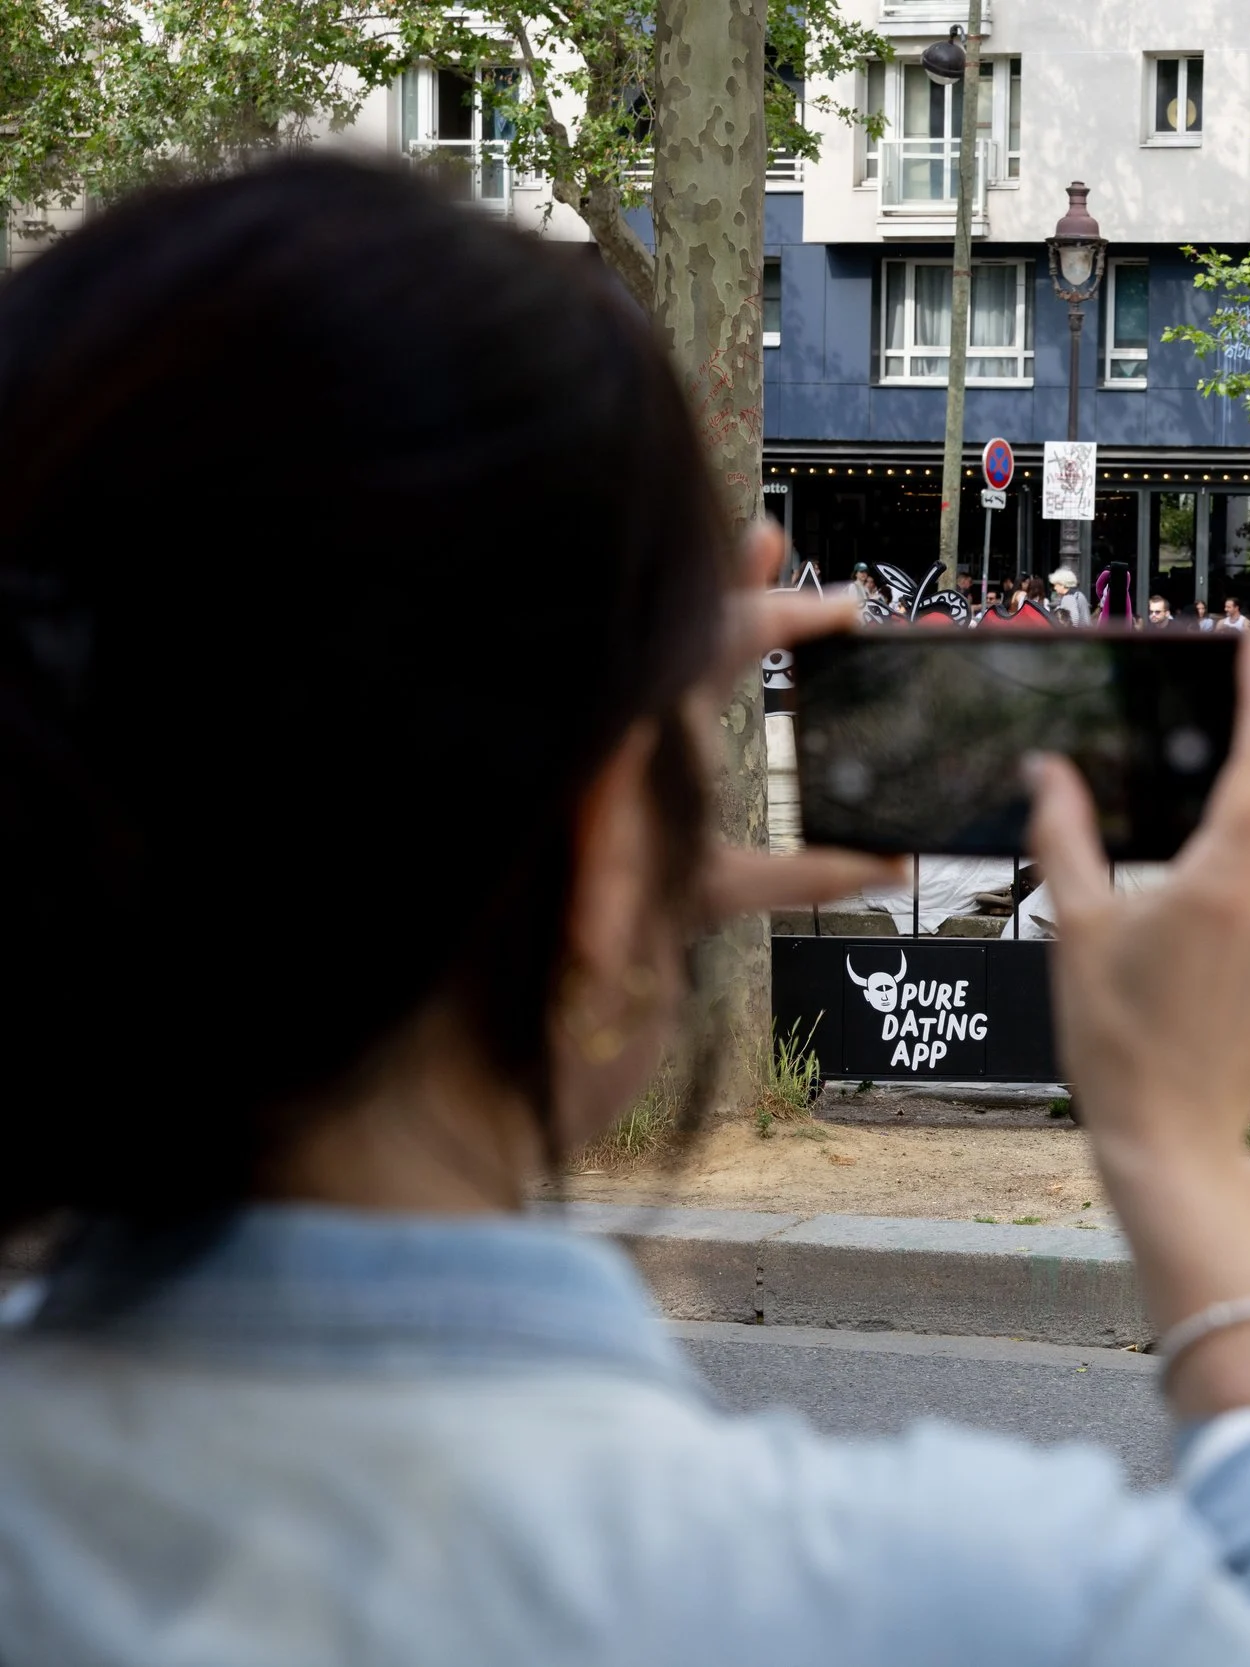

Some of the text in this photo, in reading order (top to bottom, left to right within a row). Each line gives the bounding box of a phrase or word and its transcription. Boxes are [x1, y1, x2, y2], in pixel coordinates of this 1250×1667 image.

[762, 483, 788, 494] etto
[900, 980, 969, 1010] PURE
[881, 1009, 988, 1042] DATING
[890, 1040, 947, 1071] APP
